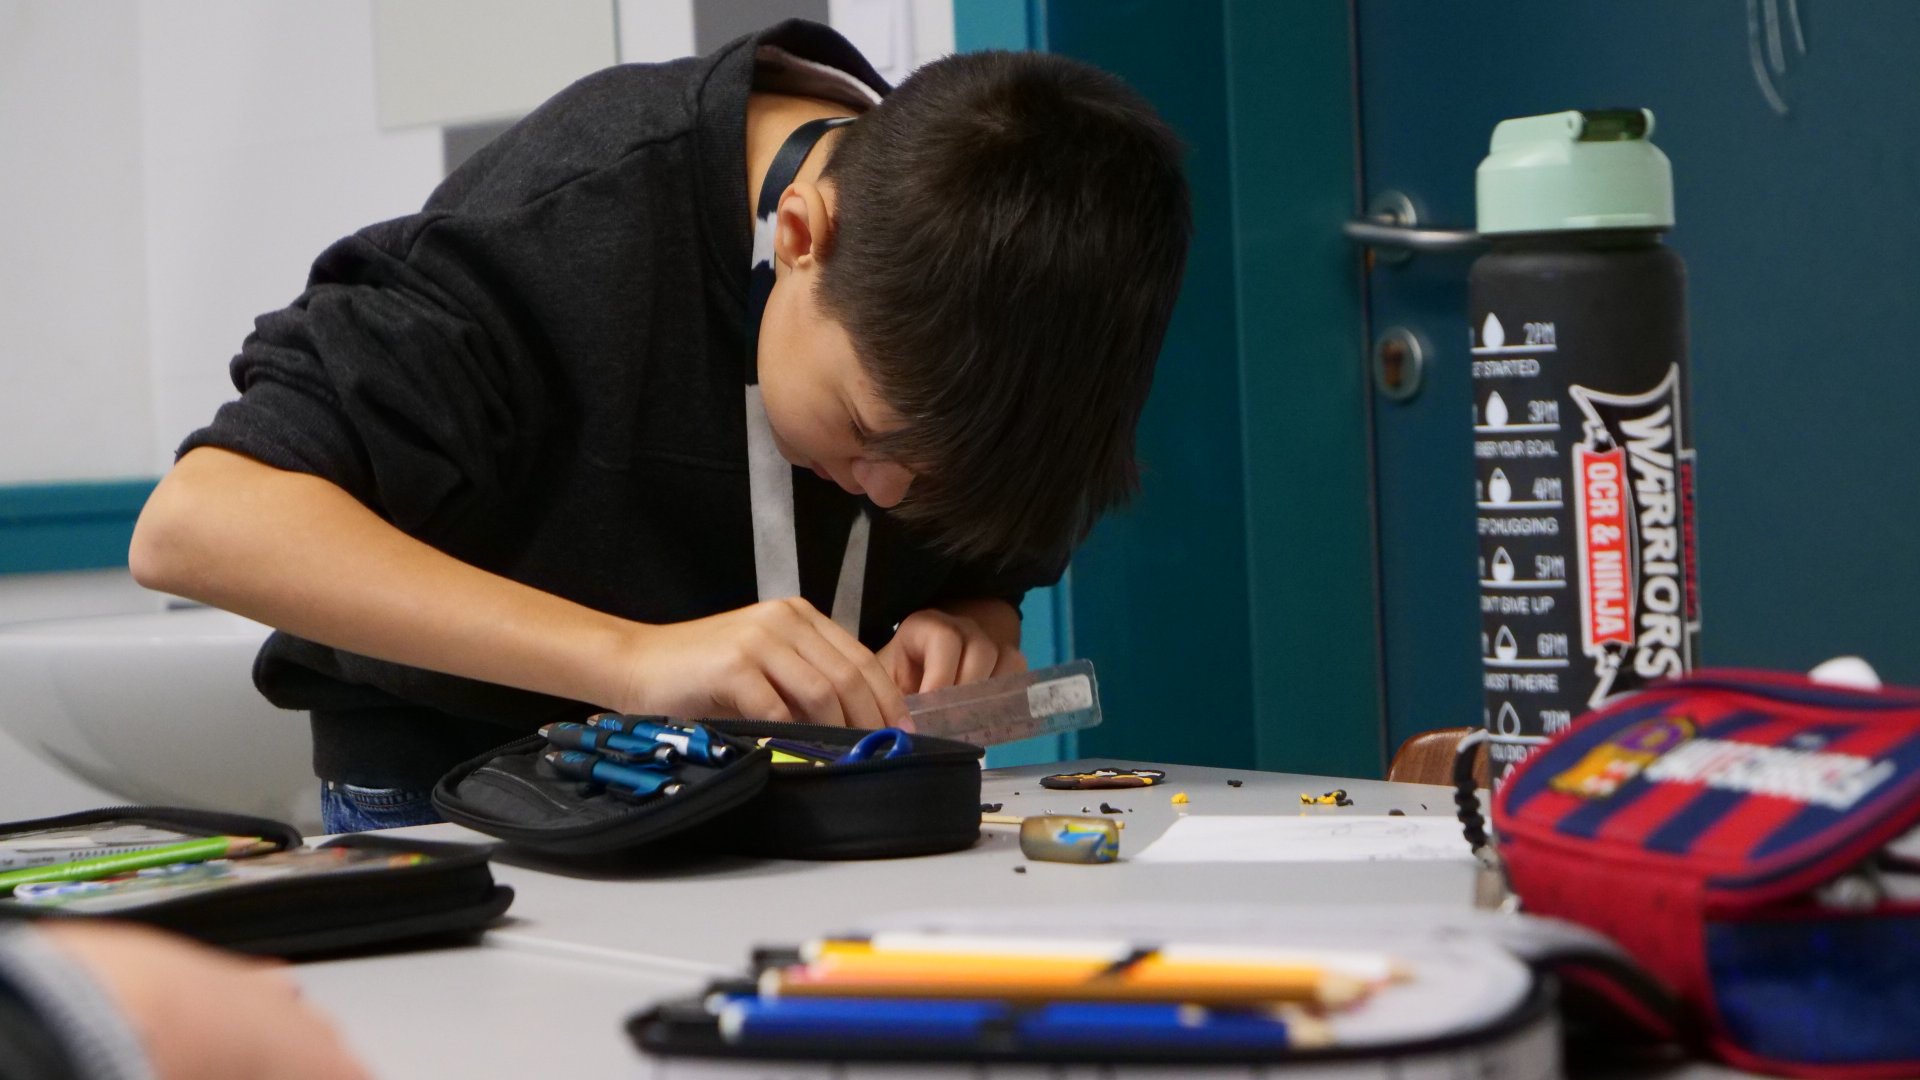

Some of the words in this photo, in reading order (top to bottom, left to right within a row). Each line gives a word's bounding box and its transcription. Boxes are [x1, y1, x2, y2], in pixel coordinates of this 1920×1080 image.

[1523, 322, 1556, 346] 2PM
[1483, 359, 1541, 378] STARTED
[1527, 400, 1559, 423] 3PM
[1525, 439, 1559, 457] GOAL
[1531, 477, 1562, 500] 4PM
[1587, 461, 1620, 518] OCR
[1590, 523, 1622, 545] &
[1619, 404, 1683, 681] WARRIORS
[1535, 554, 1566, 579] 5PM
[1592, 550, 1627, 636] NINJA
[1530, 595, 1555, 615] UP
[1537, 633, 1568, 657] 6PM
[1511, 673, 1559, 693] THERE
[1539, 710, 1571, 735] 7PM
